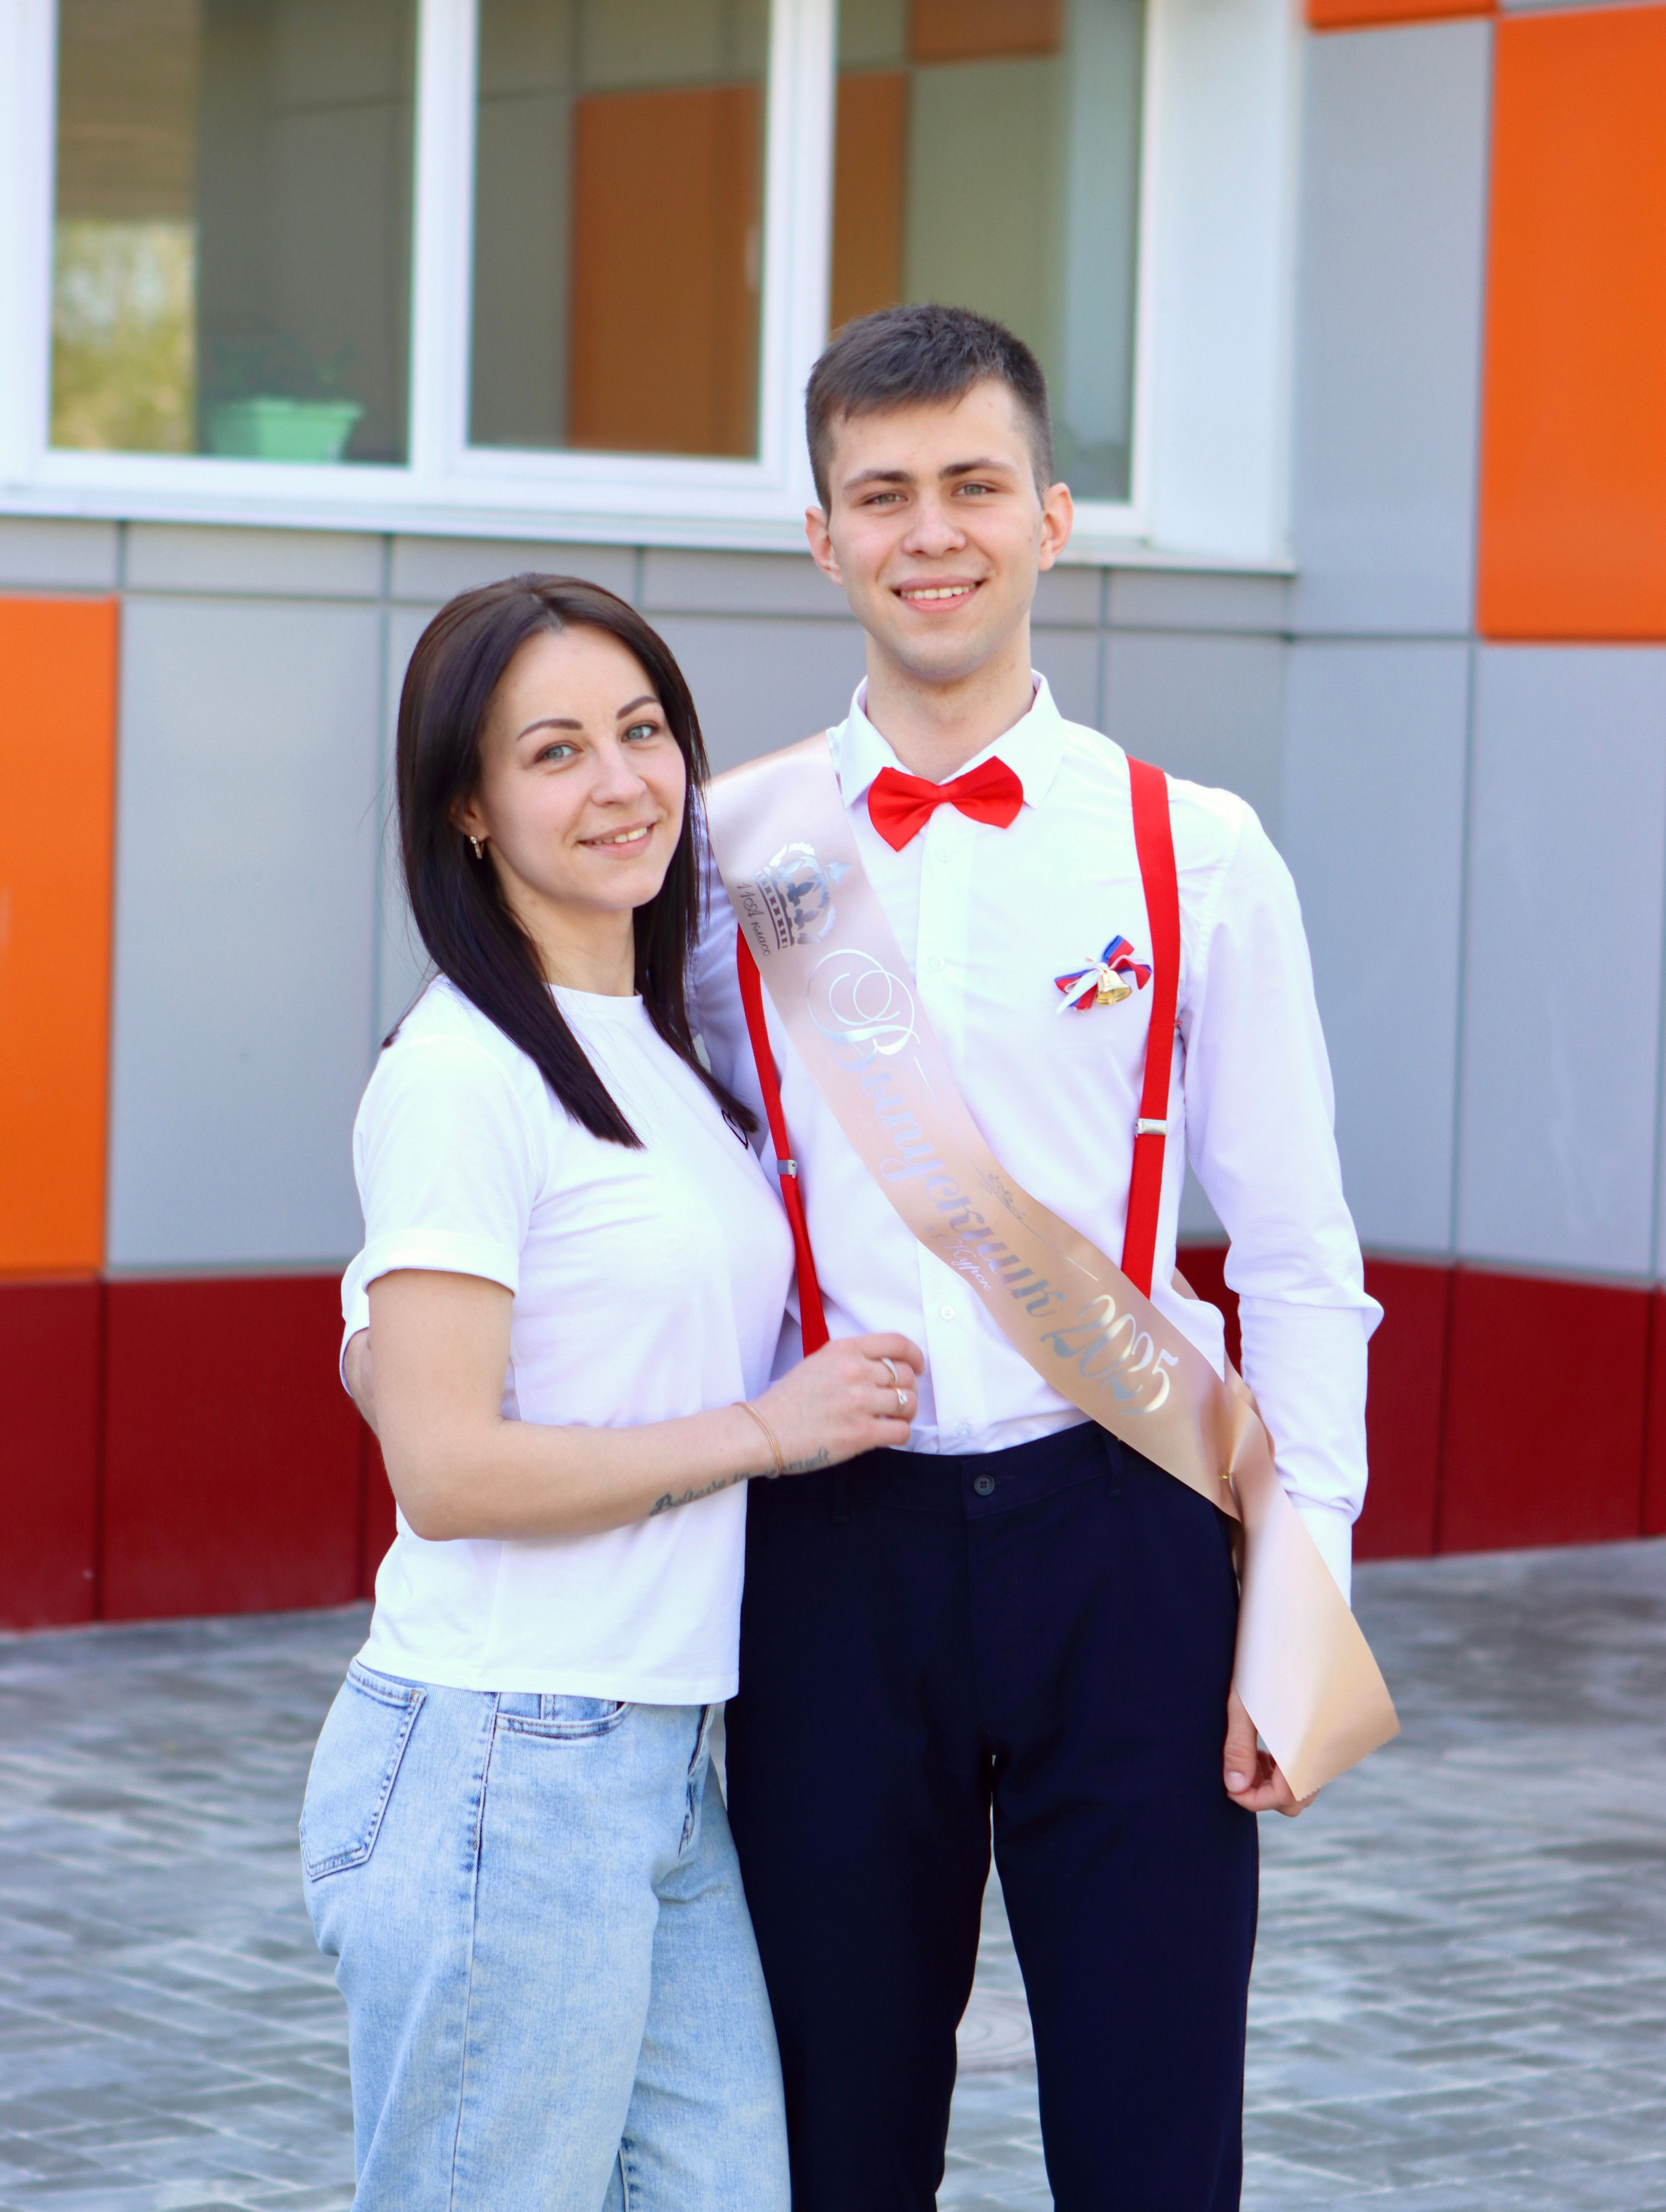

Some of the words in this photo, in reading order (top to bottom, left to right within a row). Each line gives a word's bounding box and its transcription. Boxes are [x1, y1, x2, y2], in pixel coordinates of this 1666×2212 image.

[750, 922, 771, 957] класс
[806, 948, 1066, 1318] Выпускник
[1039, 1294, 1179, 1415] 2025
[936, 1234, 991, 1291] Курск
